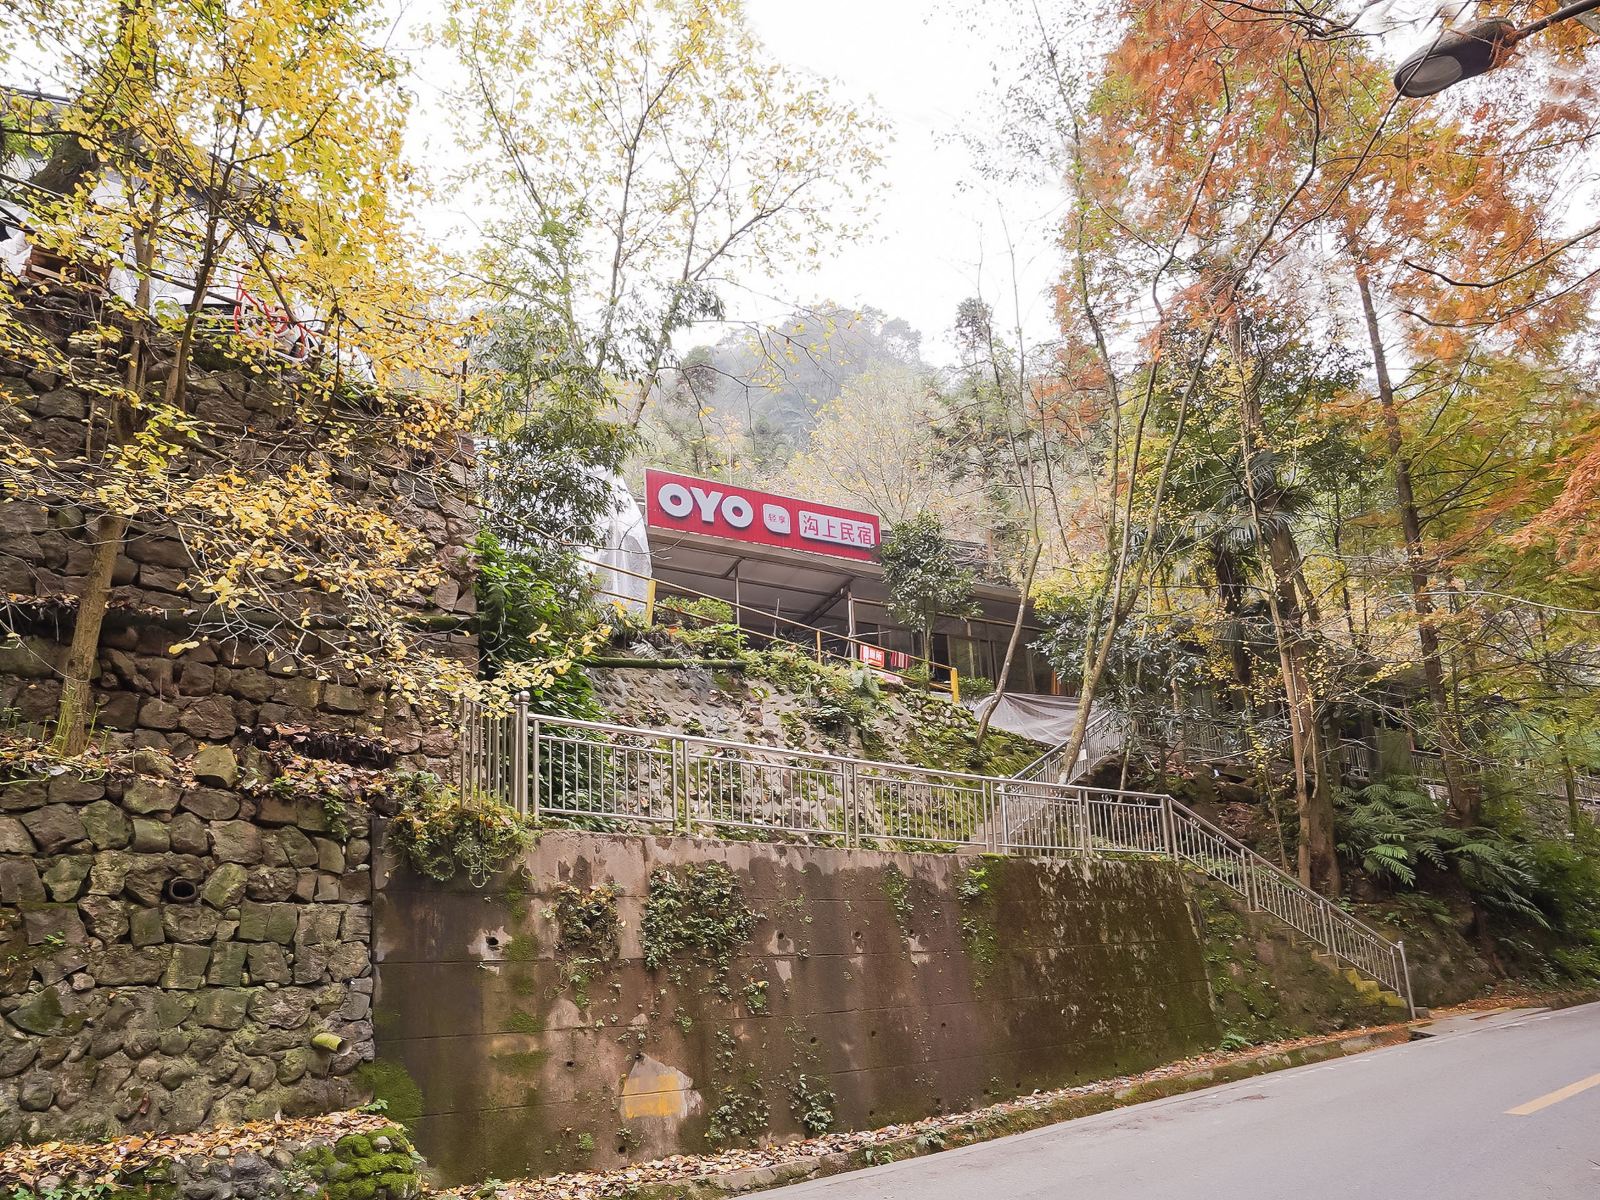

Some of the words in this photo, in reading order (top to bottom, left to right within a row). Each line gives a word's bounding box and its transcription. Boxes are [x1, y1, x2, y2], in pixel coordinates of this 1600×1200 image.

[657, 483, 754, 528] OYO
[802, 514, 872, 545] 沟上民宿
